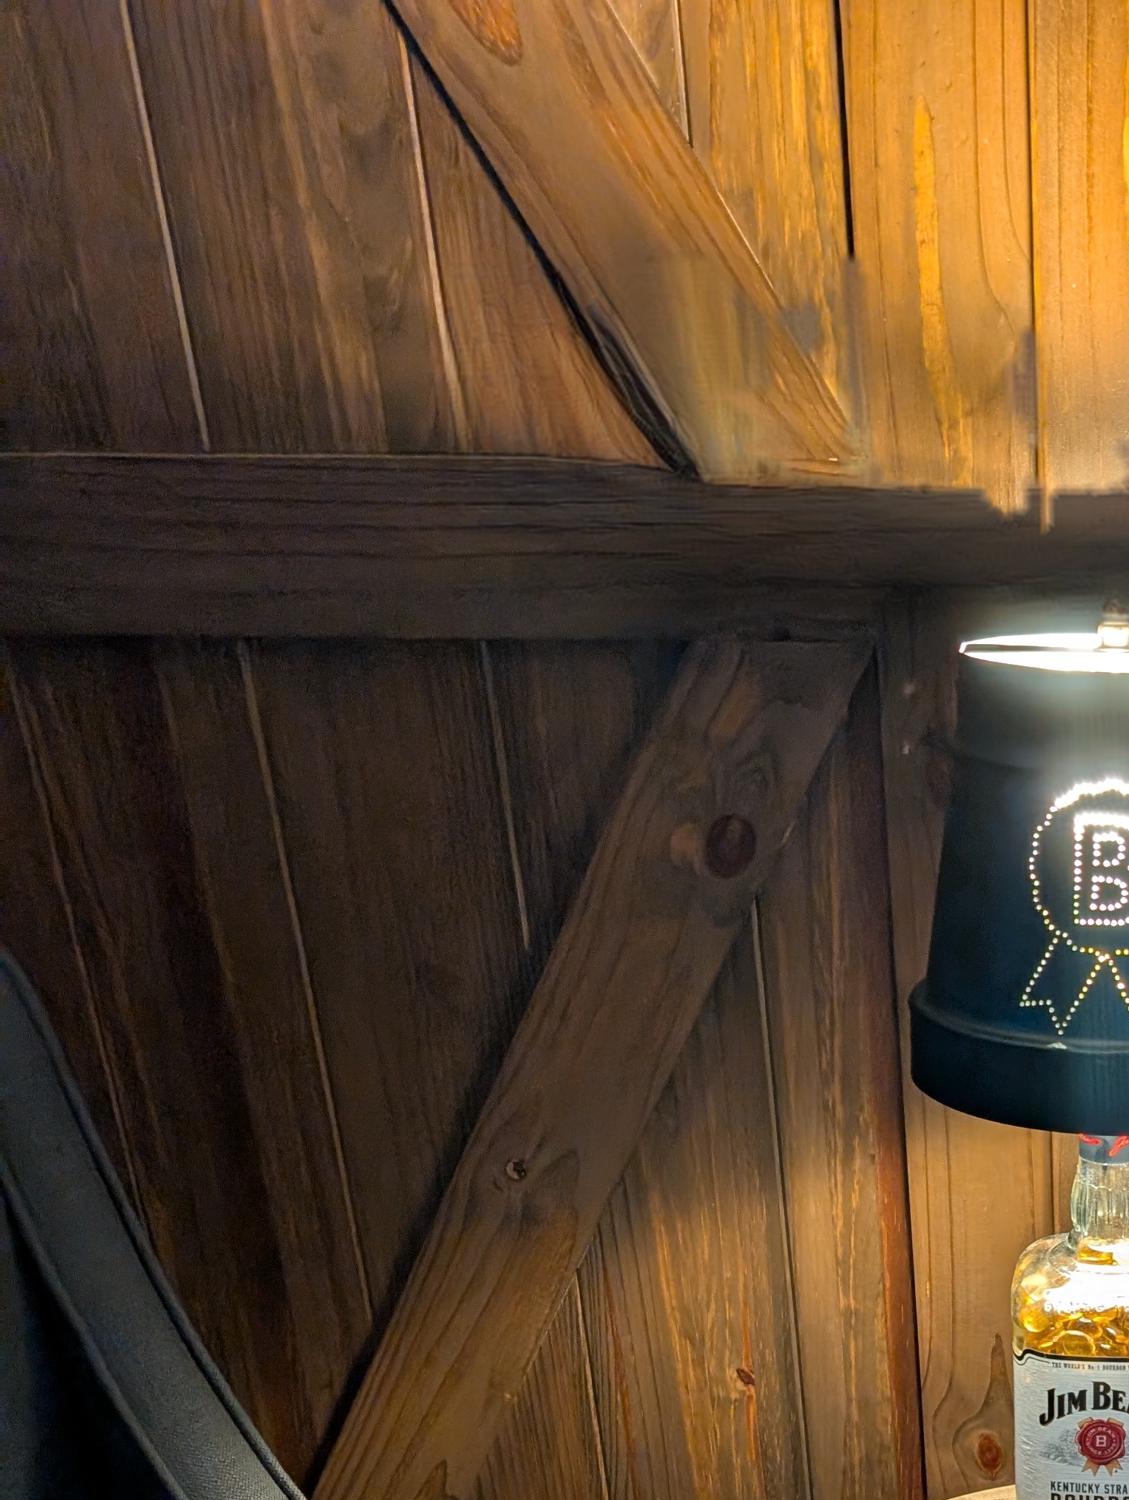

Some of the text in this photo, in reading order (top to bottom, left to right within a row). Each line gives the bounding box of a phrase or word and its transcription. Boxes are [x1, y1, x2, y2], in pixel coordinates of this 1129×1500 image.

[1038, 1387, 1088, 1426] JIM
[1095, 1434, 1107, 1447] B
[1050, 1480, 1100, 1494] KENTUCKY
